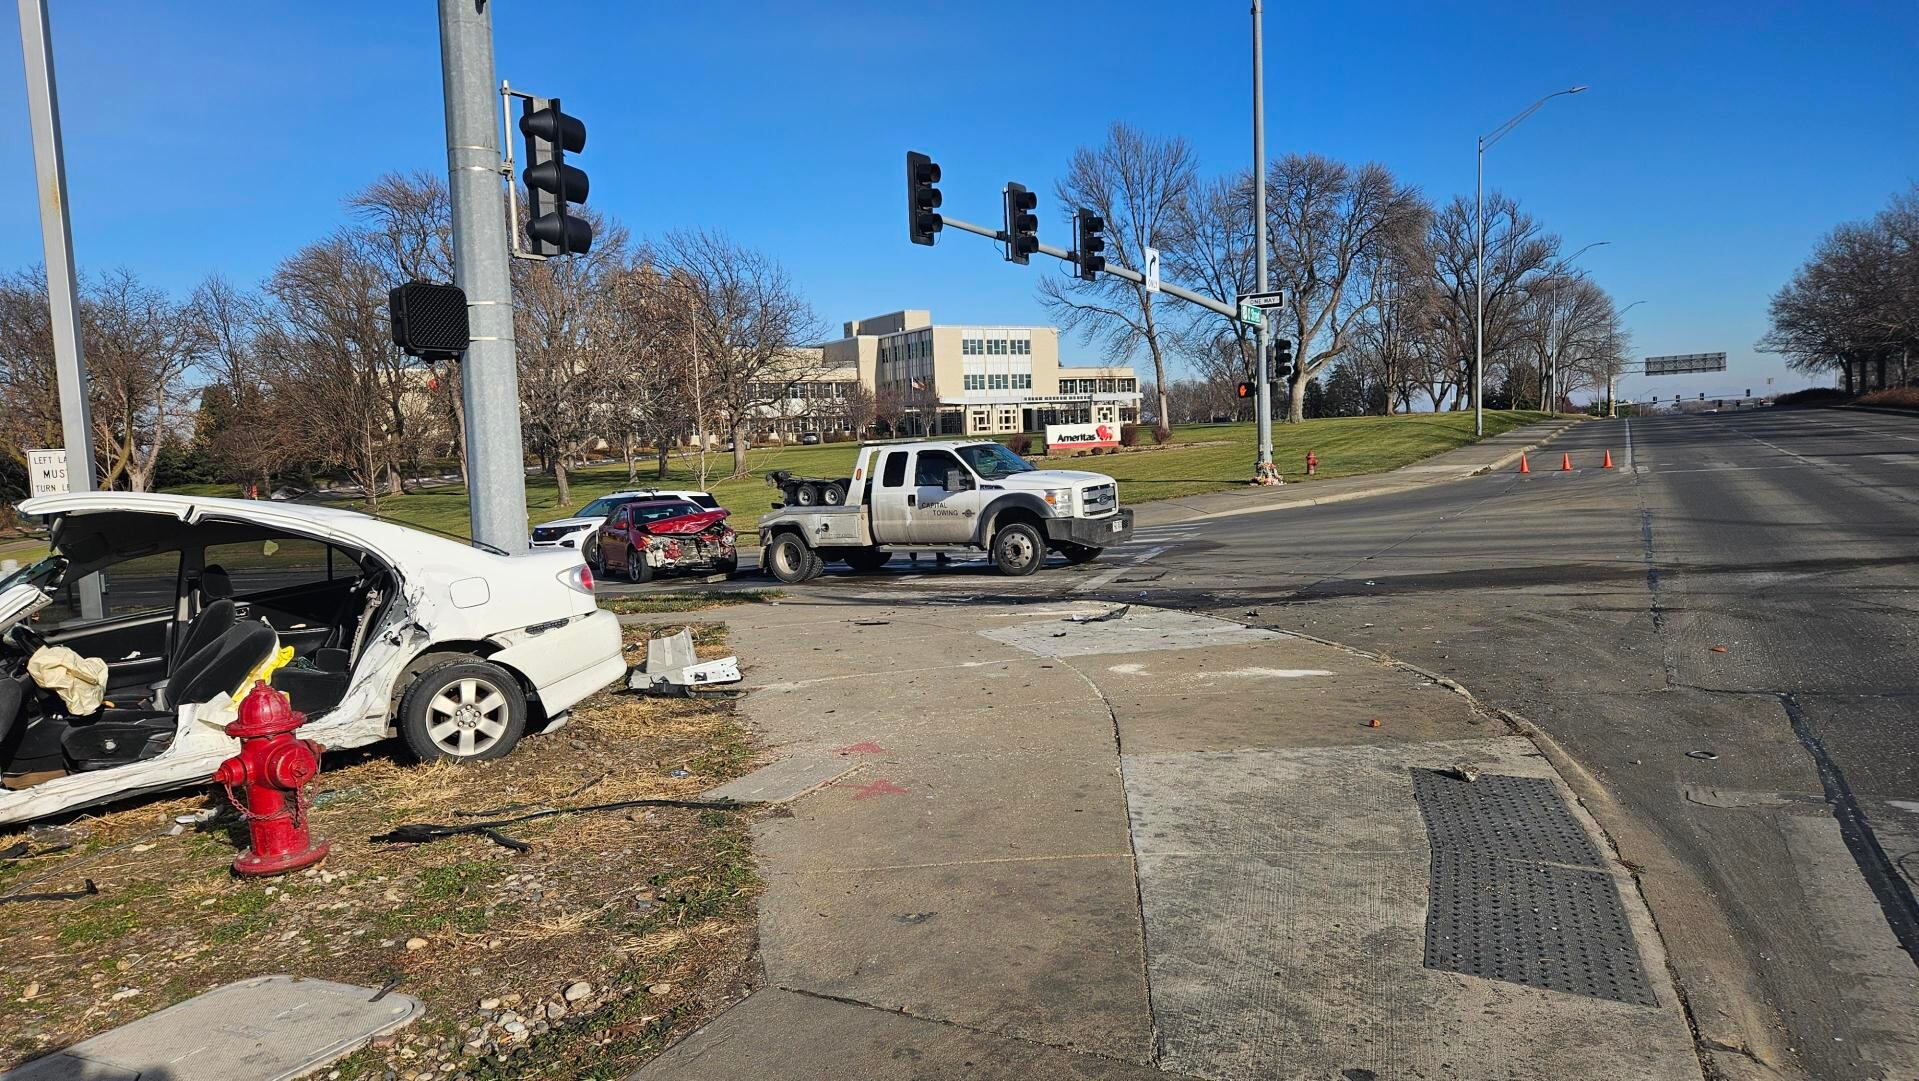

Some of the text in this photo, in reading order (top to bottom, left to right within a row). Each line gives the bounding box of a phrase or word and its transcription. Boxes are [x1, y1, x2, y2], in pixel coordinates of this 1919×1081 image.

[1057, 433, 1096, 442] Ameritas
[34, 456, 67, 464] LEFT LA
[43, 469, 65, 479] MUS
[36, 484, 56, 492] TURN
